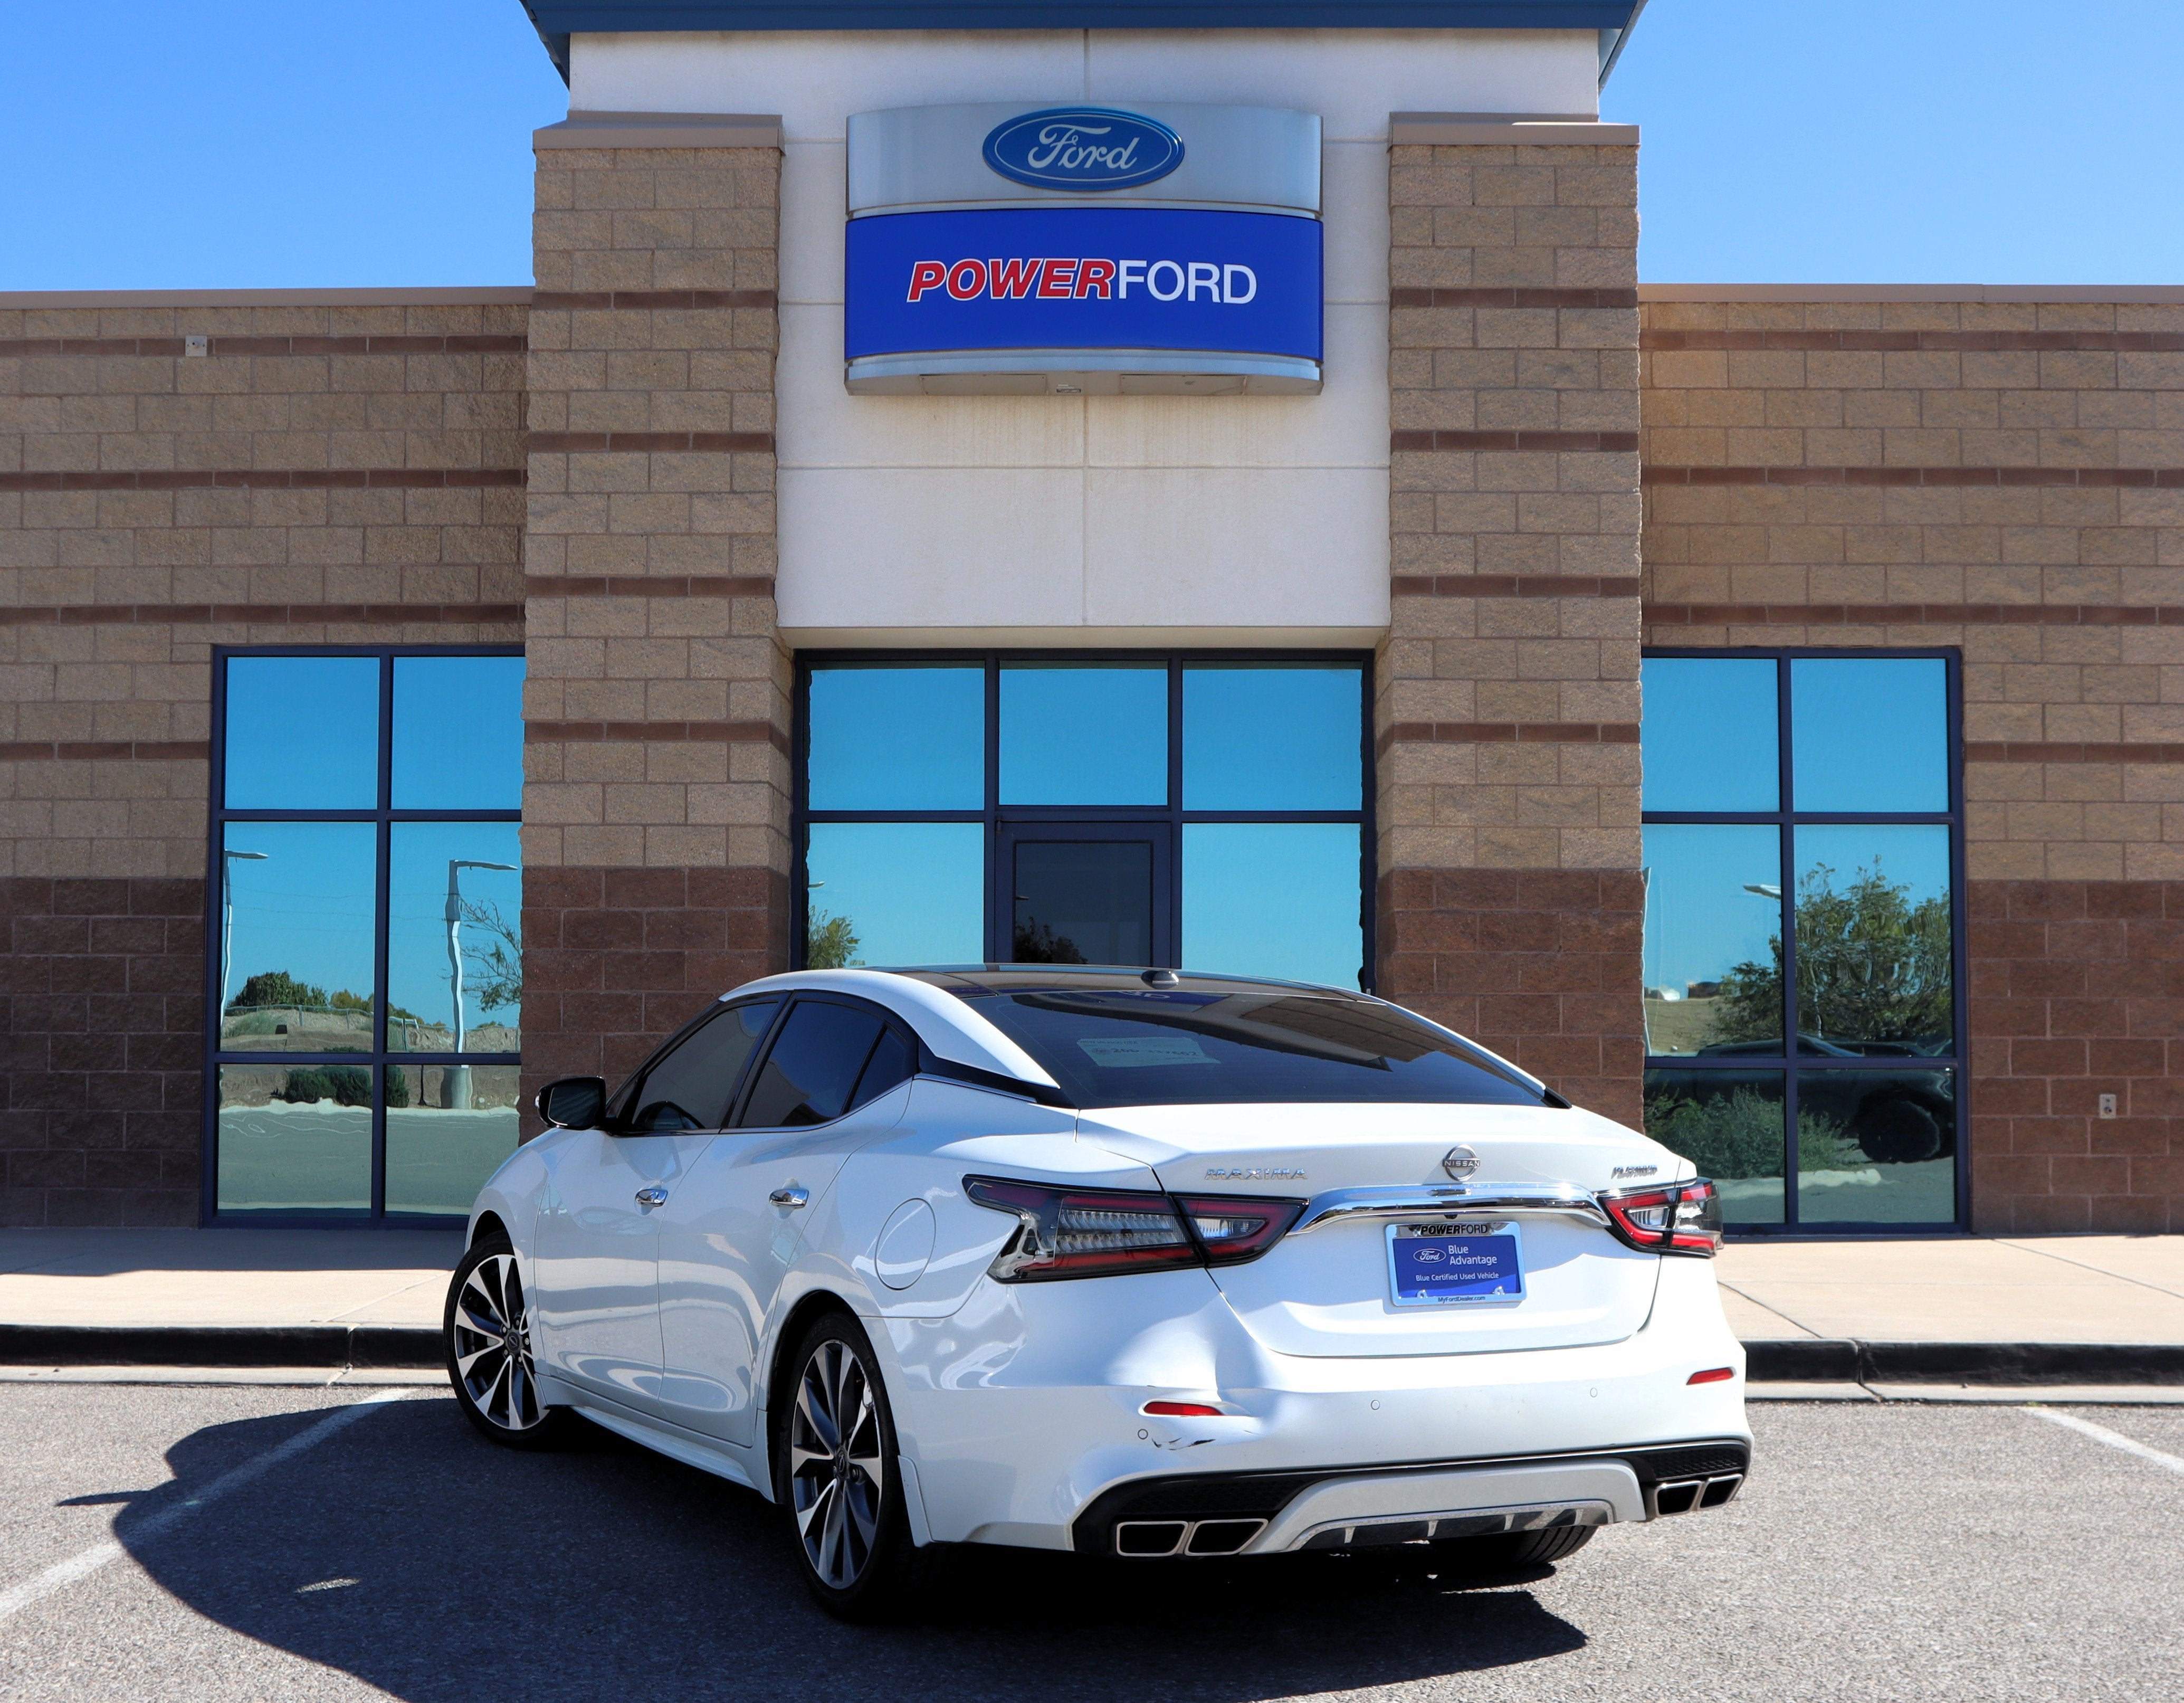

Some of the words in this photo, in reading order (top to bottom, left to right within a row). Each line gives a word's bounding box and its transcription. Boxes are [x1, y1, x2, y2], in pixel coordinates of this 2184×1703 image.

[1027, 123, 1139, 169] Ford
[907, 258, 1257, 304] POWERFORD
[1205, 1168, 1309, 1181] MAXIMA
[1420, 1224, 1488, 1235] POWERFORD
[1448, 1245, 1468, 1254] Blue
[1419, 1250, 1441, 1261] Ford
[1449, 1255, 1498, 1266] Advantage
[1431, 1272, 1458, 1281] Certified
[1477, 1271, 1500, 1280] Vehicle
